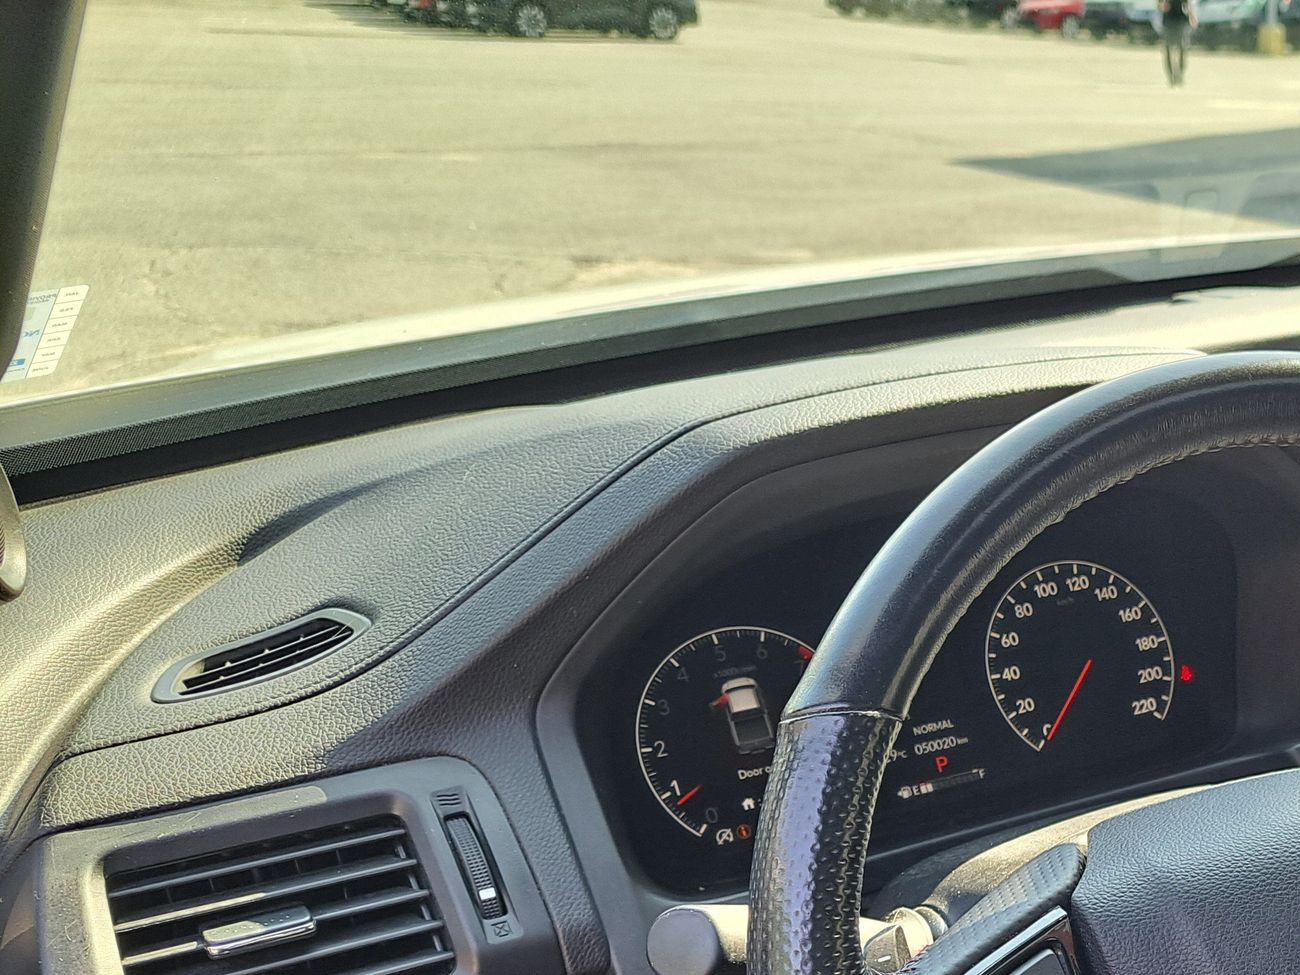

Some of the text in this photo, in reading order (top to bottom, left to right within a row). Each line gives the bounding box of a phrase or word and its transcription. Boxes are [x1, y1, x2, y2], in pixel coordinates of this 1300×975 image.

[1034, 582, 1058, 598] 100
[1066, 575, 1090, 592] 120
[1094, 585, 1118, 602] 140
[1014, 603, 1033, 618] 80
[1118, 607, 1141, 623] 160
[1001, 632, 1019, 648] 60
[1135, 635, 1158, 651] 180
[1002, 666, 1020, 681] 40
[1137, 666, 1163, 683] 200
[1016, 698, 1035, 714] 20
[1132, 698, 1157, 715] 220
[912, 719, 954, 736] NORMAL
[654, 740, 668, 758] 2
[914, 736, 956, 755] 050020
[935, 756, 949, 773] P
[738, 768, 763, 781] Door
[670, 779, 680, 796] 1
